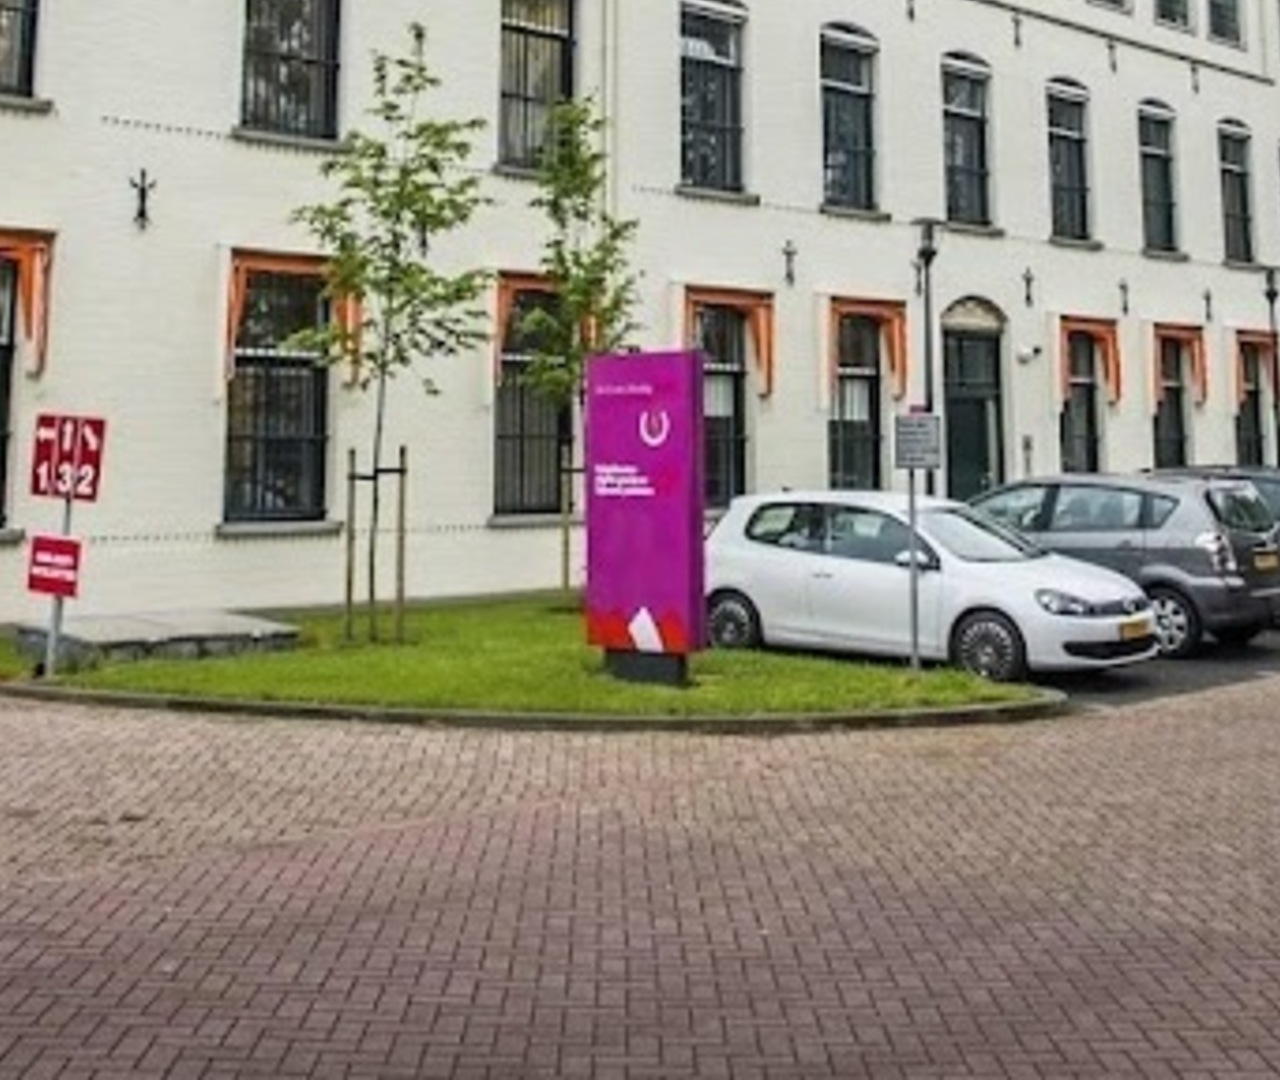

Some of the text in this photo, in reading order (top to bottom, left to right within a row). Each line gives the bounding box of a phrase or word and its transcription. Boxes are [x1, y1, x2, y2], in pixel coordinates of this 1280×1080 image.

[36, 461, 94, 495] 1 3 2
